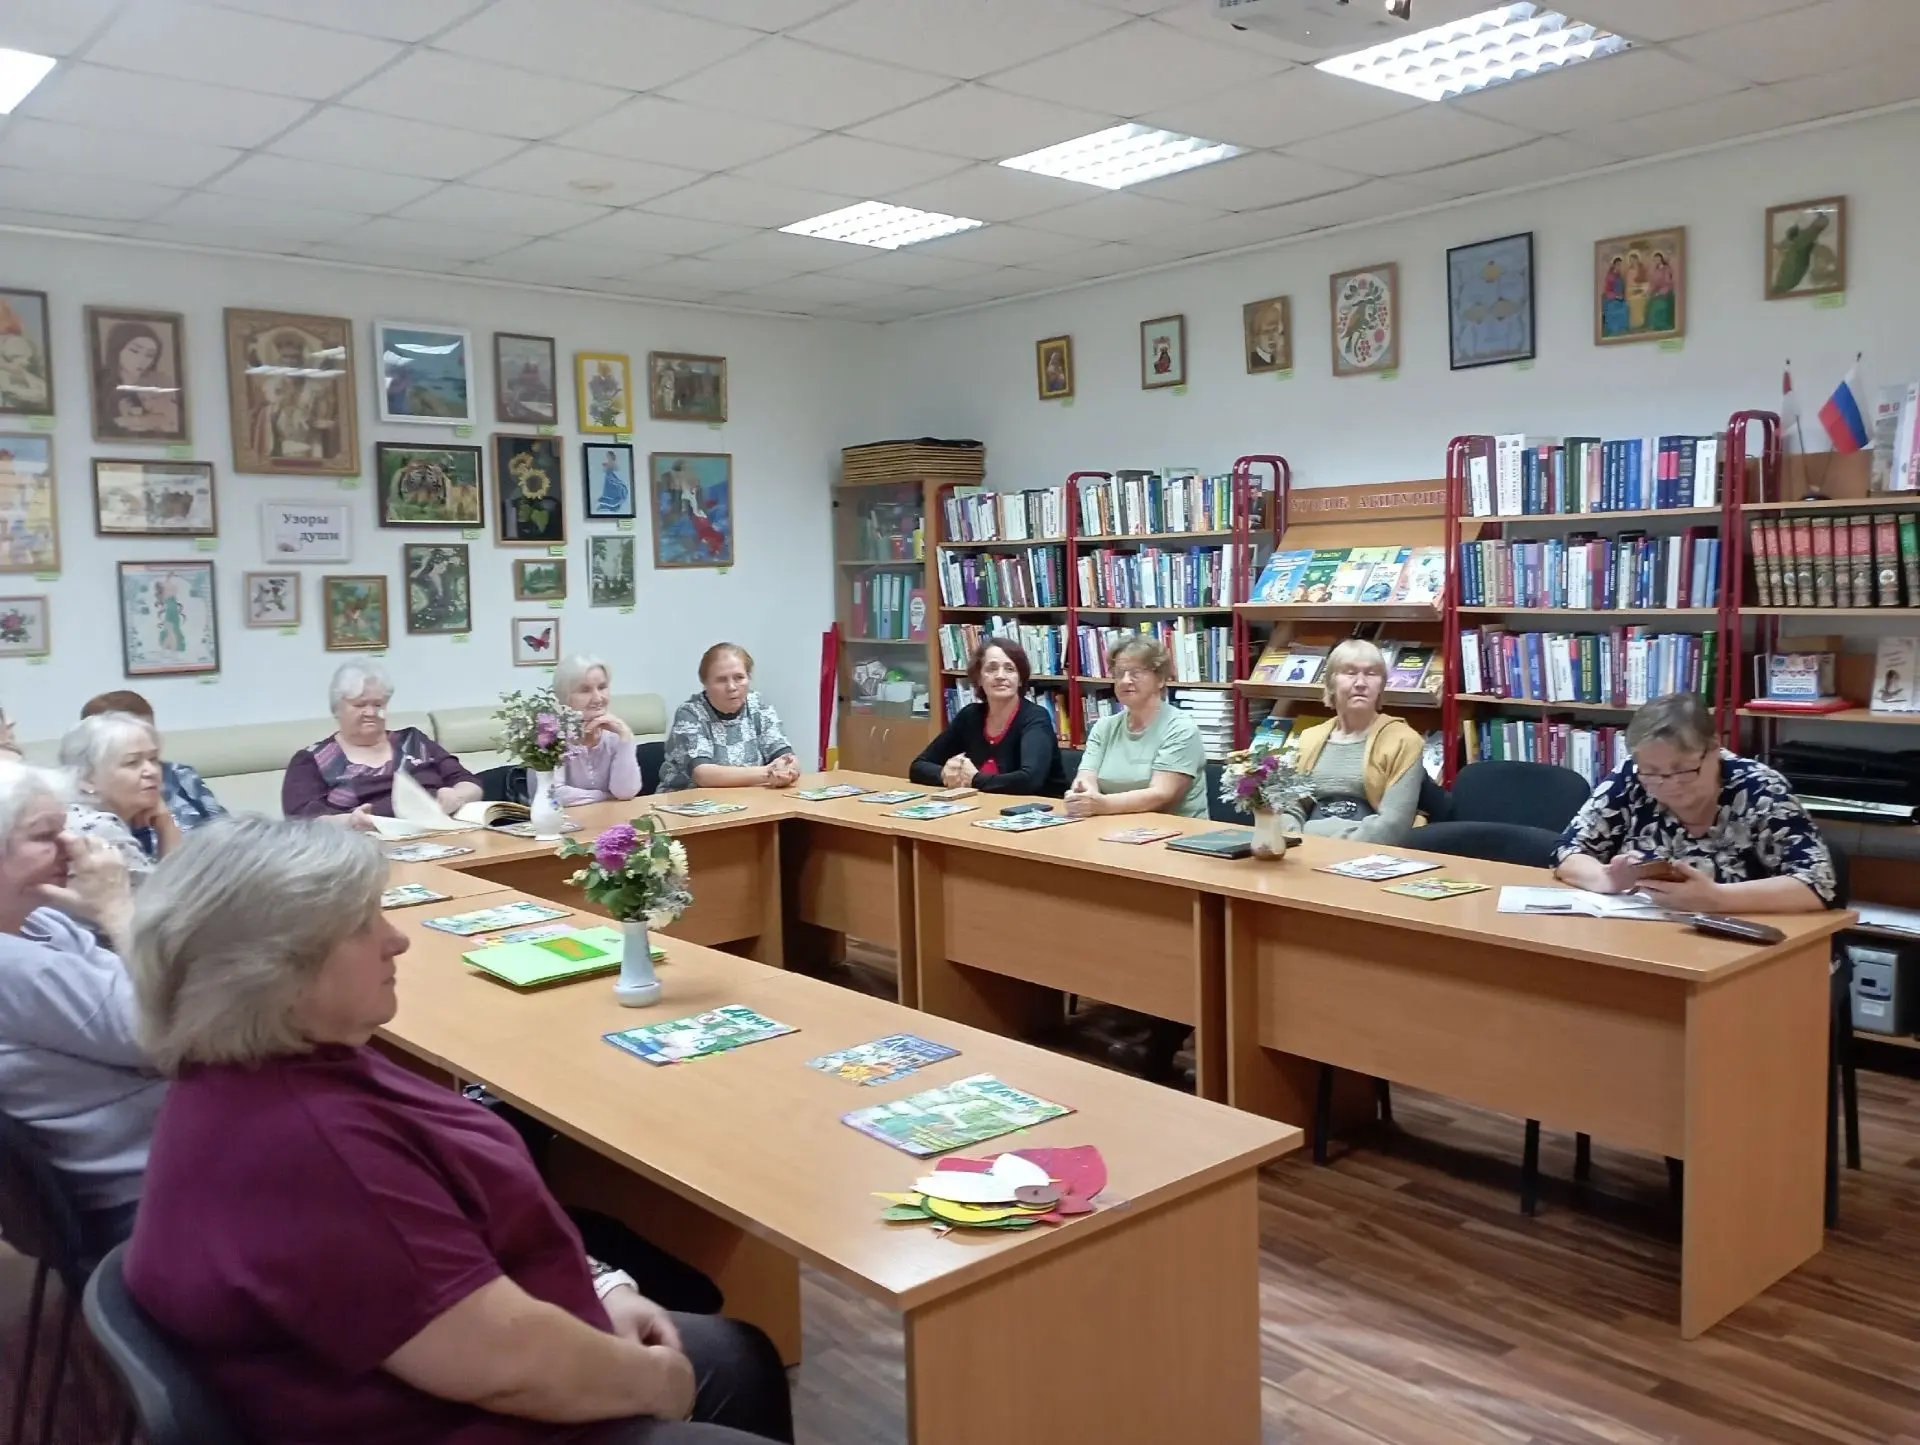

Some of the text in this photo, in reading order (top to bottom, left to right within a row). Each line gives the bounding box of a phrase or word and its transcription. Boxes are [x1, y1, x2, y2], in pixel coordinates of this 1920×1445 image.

[1357, 489, 1448, 508] АБИТУРИЕ
[282, 513, 329, 527] Узоры
[299, 532, 339, 543] души
